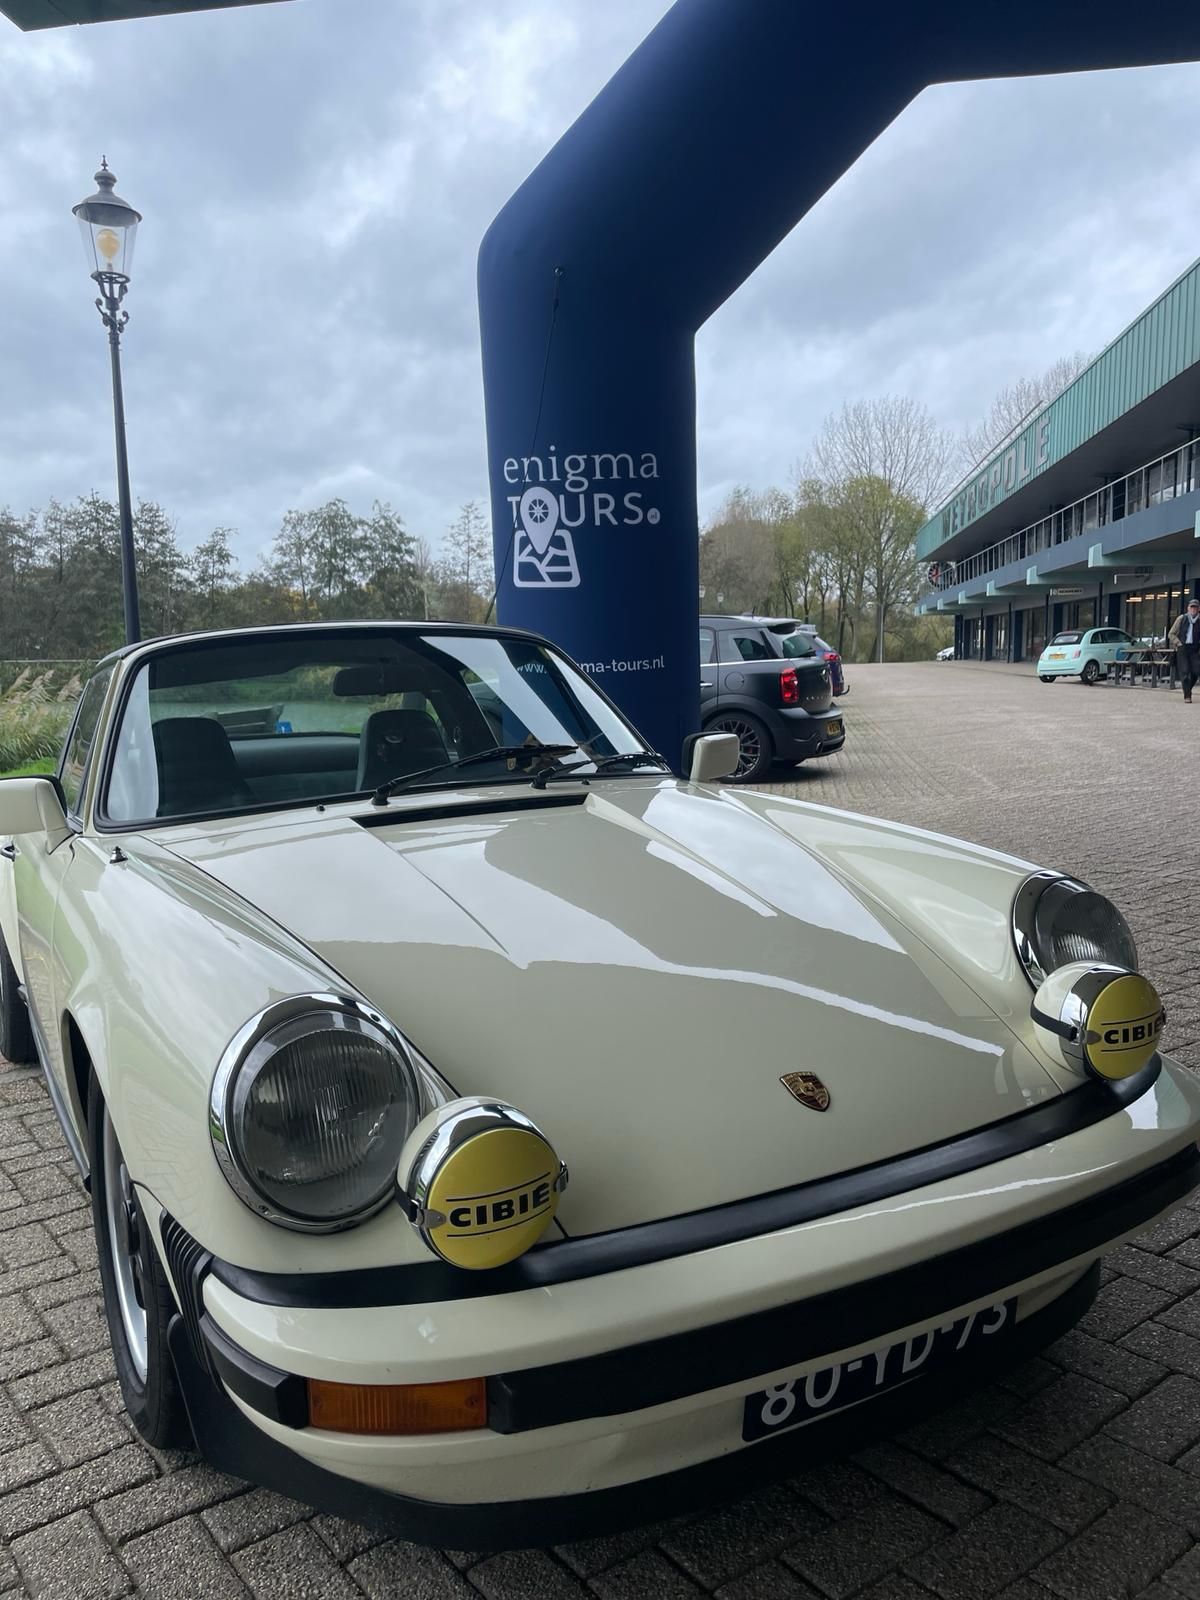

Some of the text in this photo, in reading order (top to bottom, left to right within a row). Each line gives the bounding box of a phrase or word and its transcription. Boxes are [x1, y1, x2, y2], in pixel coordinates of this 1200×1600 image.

[504, 446, 660, 492] enigma
[942, 415, 1050, 539] METROPOLE
[450, 1182, 550, 1227] CIBIE
